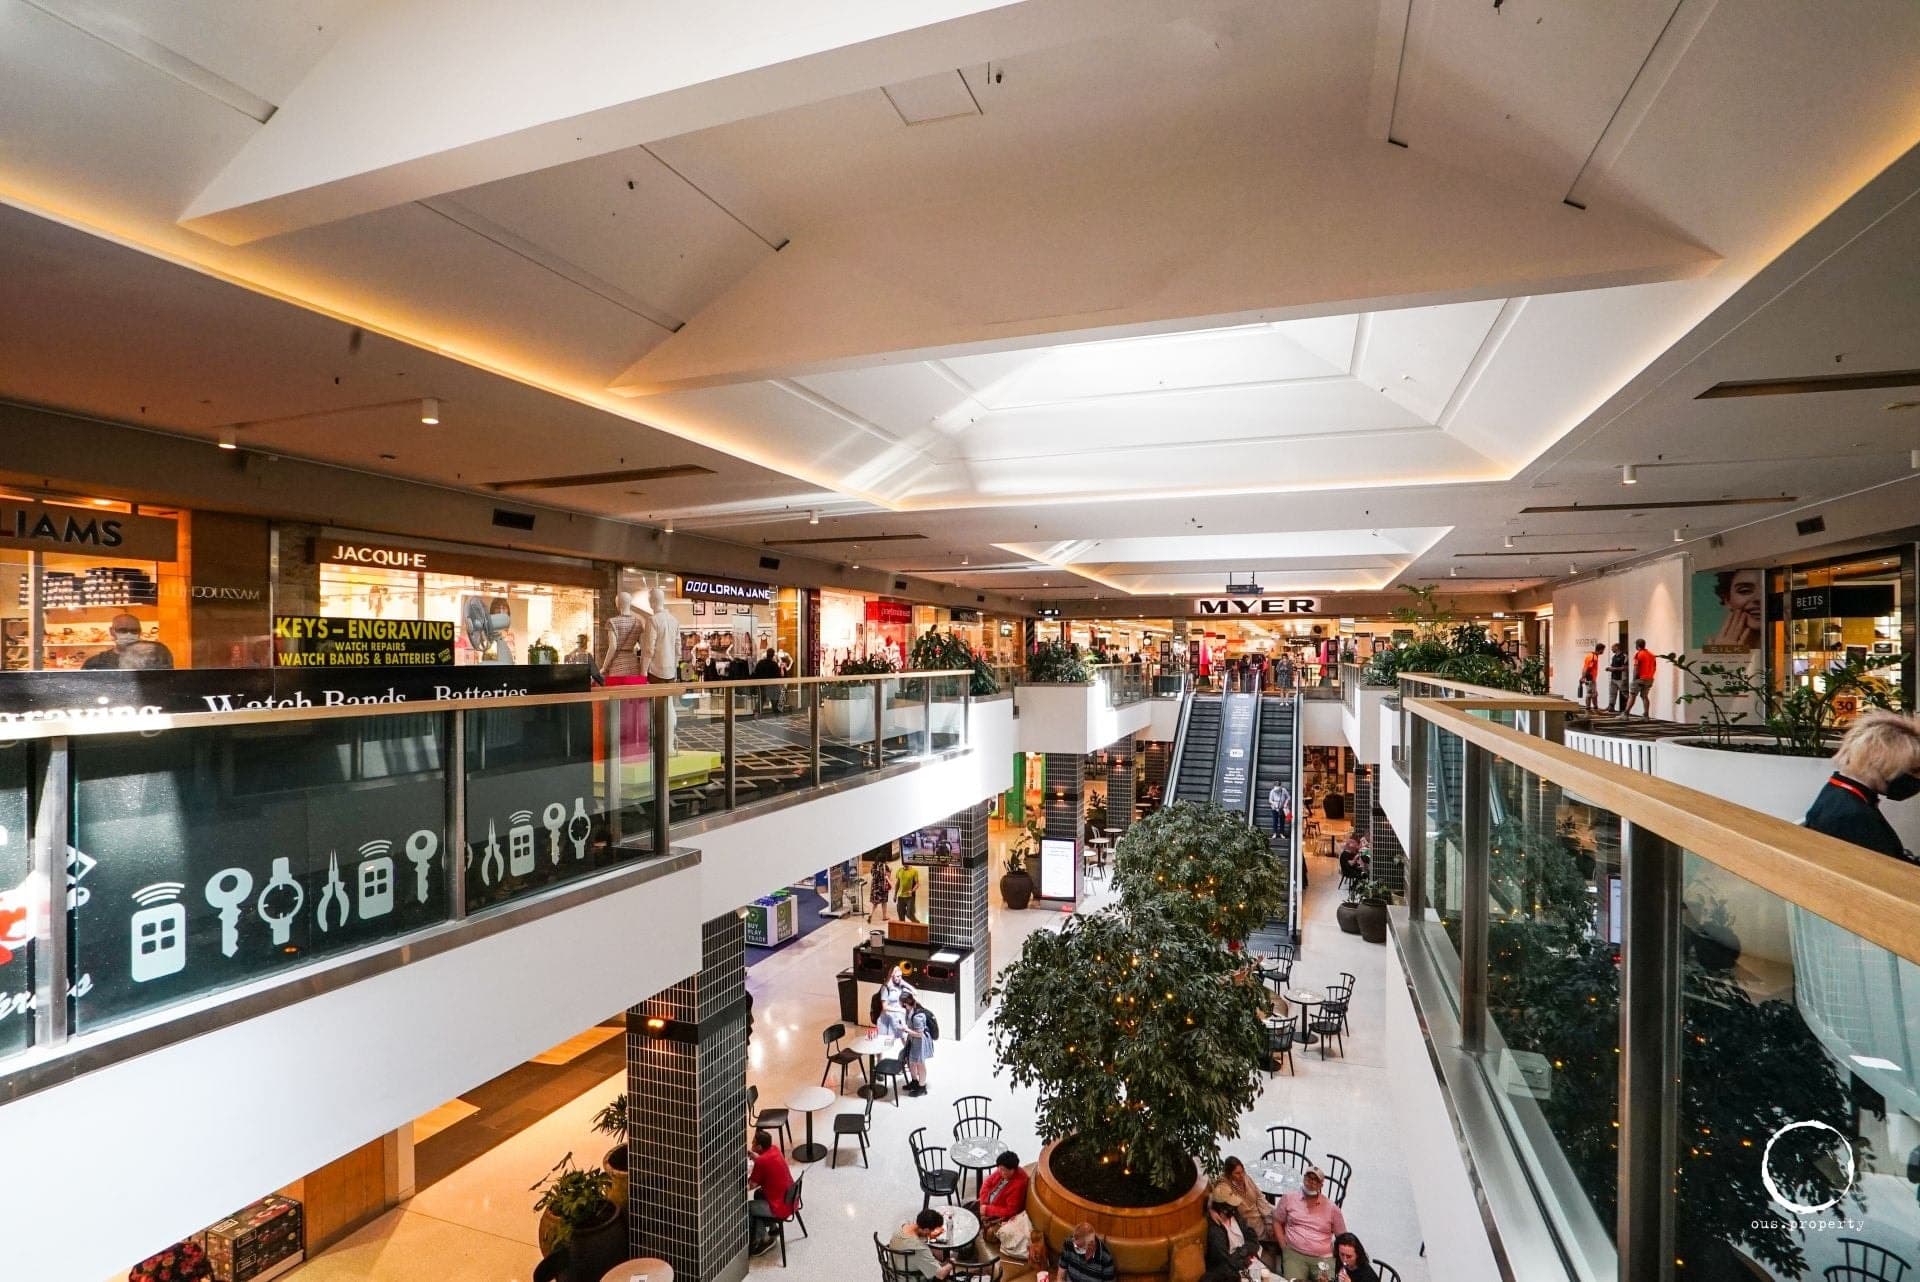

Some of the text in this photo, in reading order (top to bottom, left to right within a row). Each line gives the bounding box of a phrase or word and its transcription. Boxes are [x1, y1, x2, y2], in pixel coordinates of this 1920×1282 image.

[709, 583, 771, 600] LORNA JANE
[1200, 600, 1314, 613] MYER
[1796, 595, 1824, 608] BETTS
[276, 617, 329, 639] KEYS
[348, 619, 453, 640] ENGRAVING
[334, 641, 406, 652] WATCH REPAIRS
[278, 653, 326, 666] WATCH
[329, 653, 370, 665] BANDS
[373, 652, 382, 665] &
[385, 652, 436, 665] BATTERIES
[1837, 701, 1854, 711] 30
